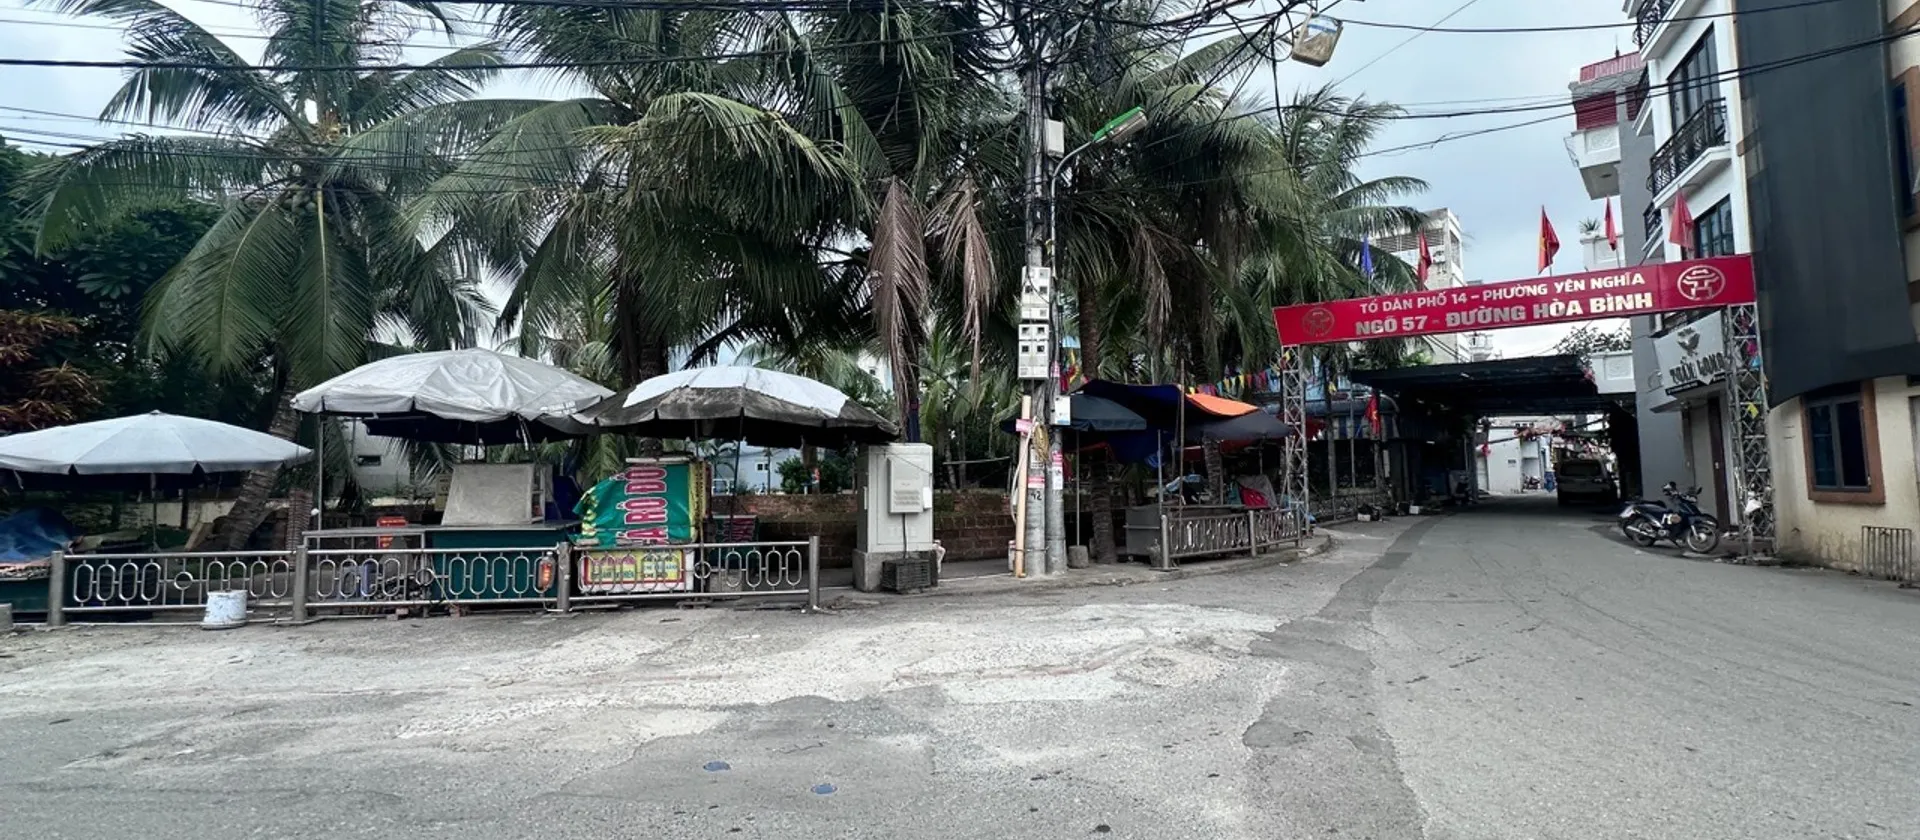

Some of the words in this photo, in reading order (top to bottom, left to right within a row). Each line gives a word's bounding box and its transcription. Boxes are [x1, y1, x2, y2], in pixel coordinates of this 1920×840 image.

[1417, 291, 1447, 308] PHỐ
[1452, 292, 1468, 304] 14
[1482, 283, 1548, 301] PHƯỜNG
[1554, 278, 1585, 293] YÊN
[1590, 271, 1645, 289] NGHĨA
[1355, 315, 1397, 335] NGÕ
[1402, 315, 1428, 331] 57
[1445, 305, 1526, 327] ĐƯỜNG
[1533, 298, 1583, 319] HÒA
[1589, 292, 1653, 314] BÌNH
[616, 496, 668, 524] RÔ
